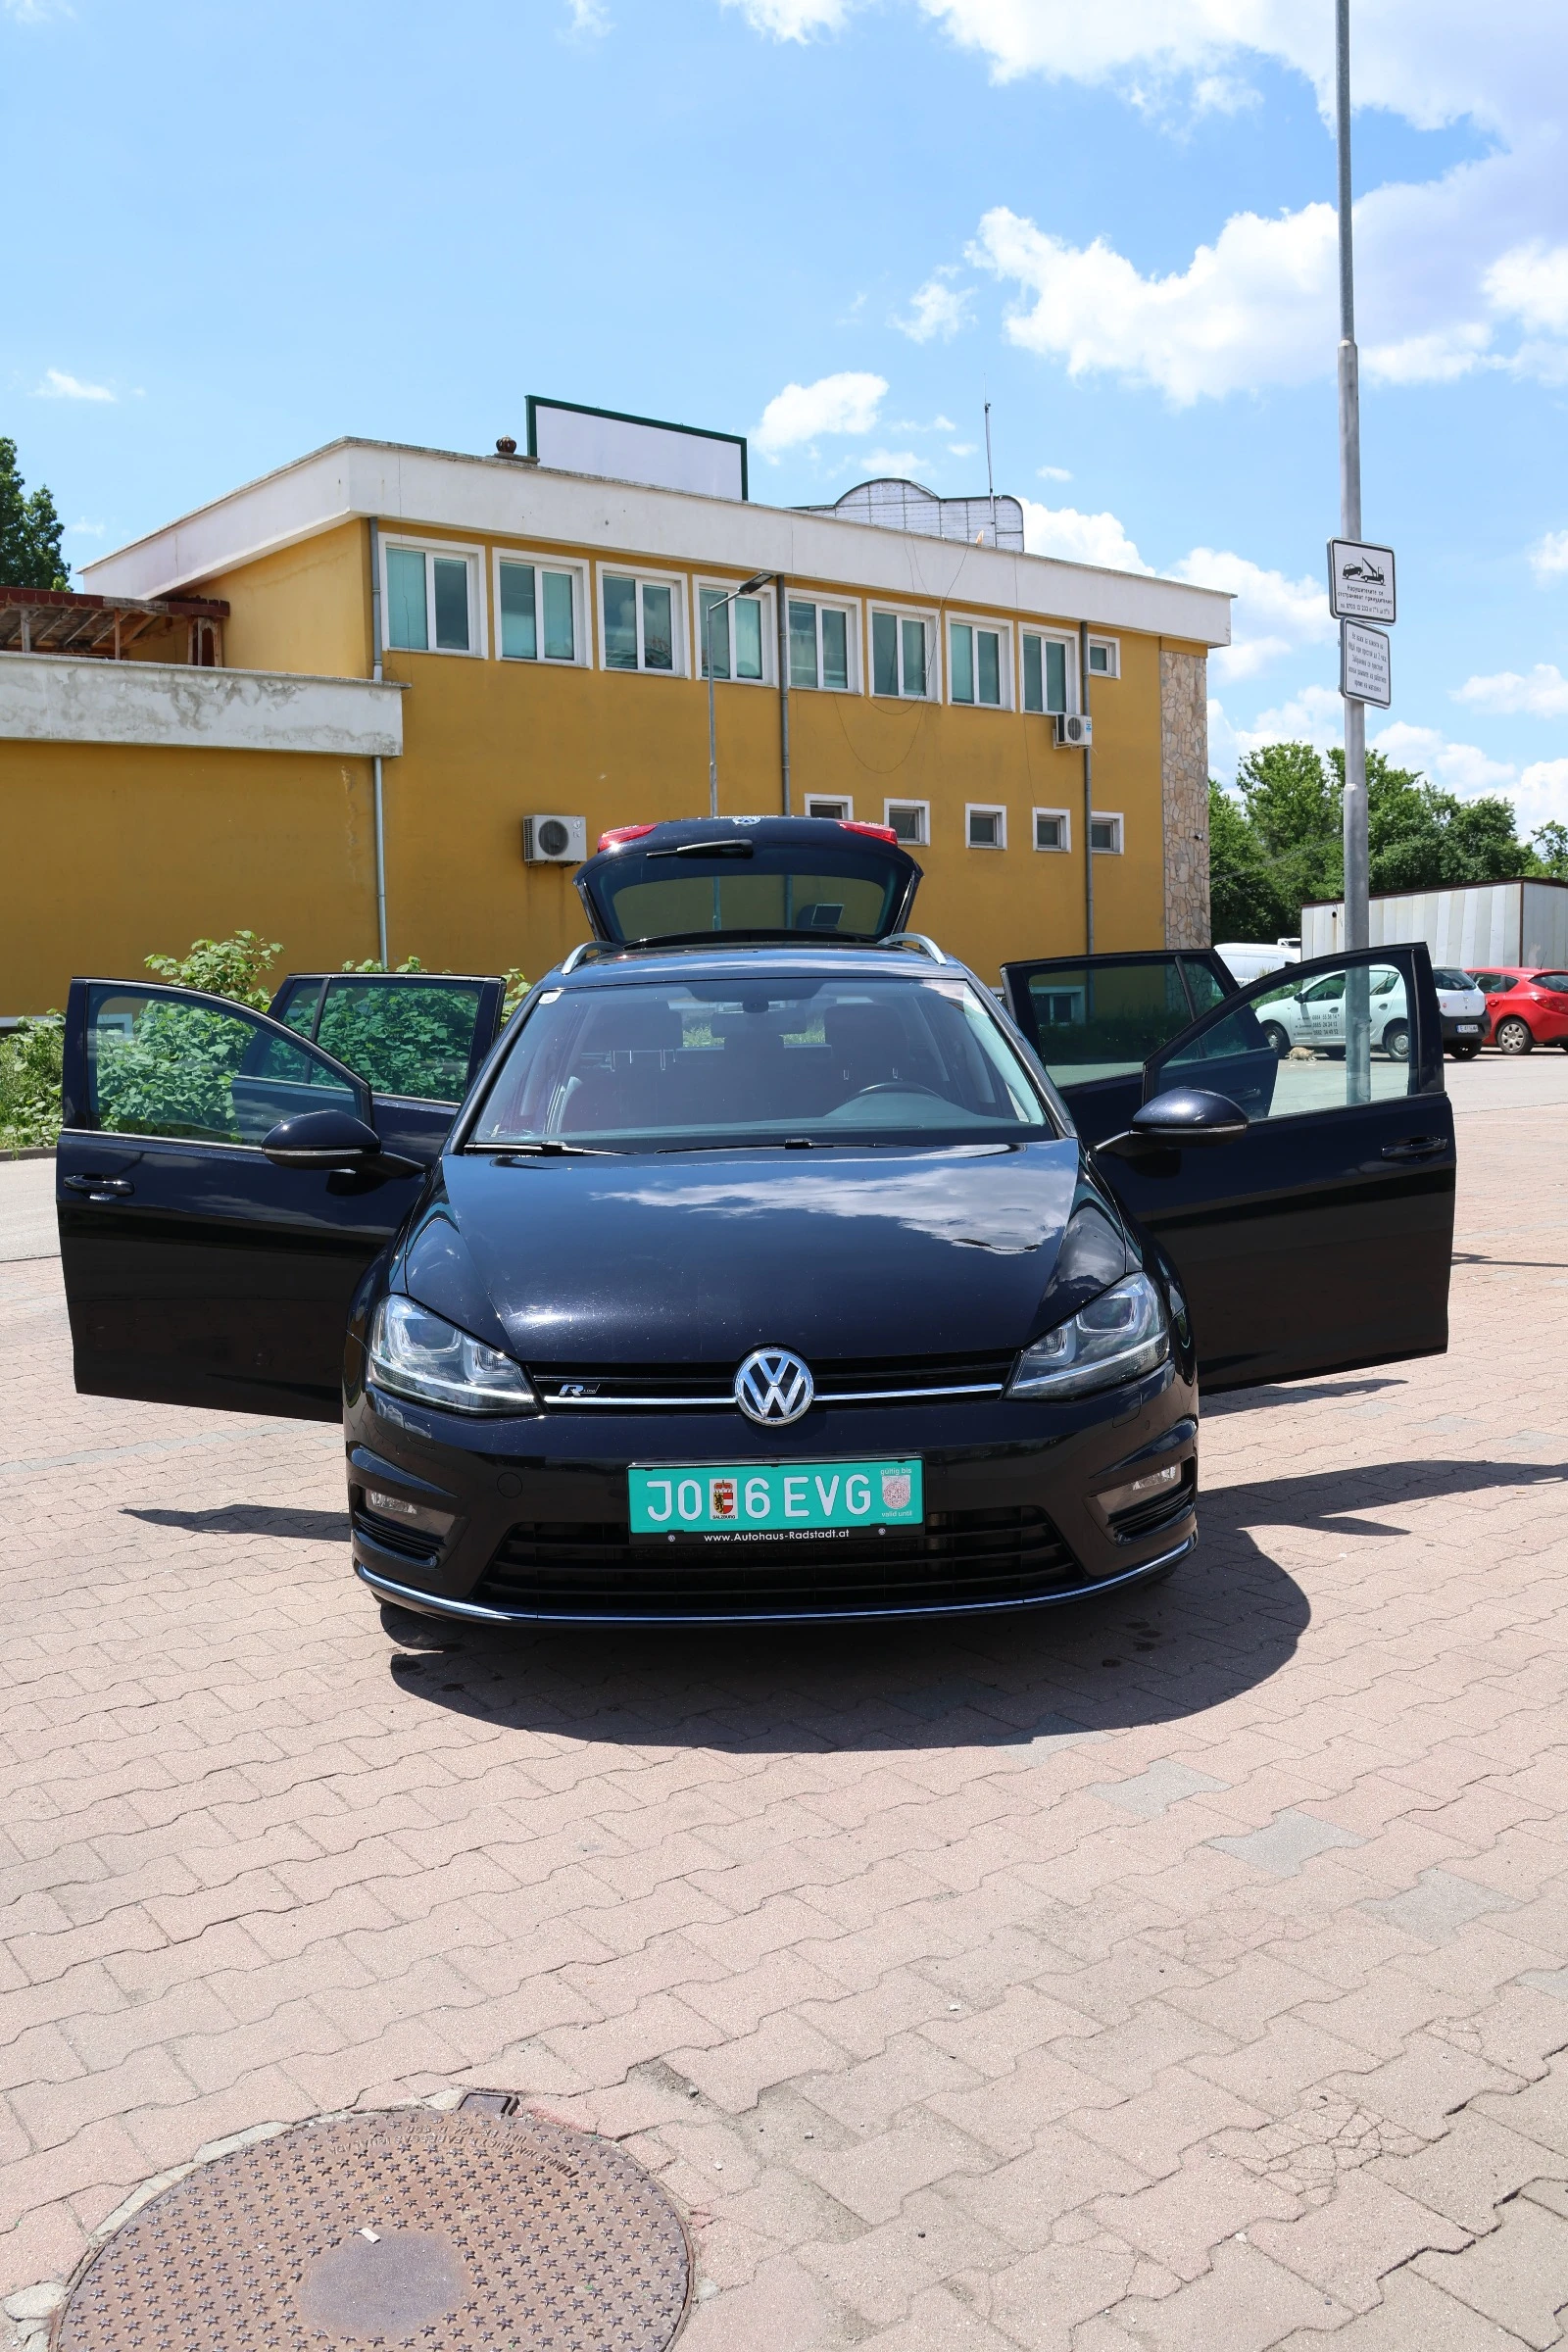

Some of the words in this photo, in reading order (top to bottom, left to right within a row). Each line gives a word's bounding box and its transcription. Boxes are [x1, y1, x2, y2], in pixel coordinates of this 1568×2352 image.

[880, 1467, 900, 1476] gültig
[646, 1479, 703, 1522] JO
[704, 1529, 851, 1544] www.Autohaus-Radstadt.at
